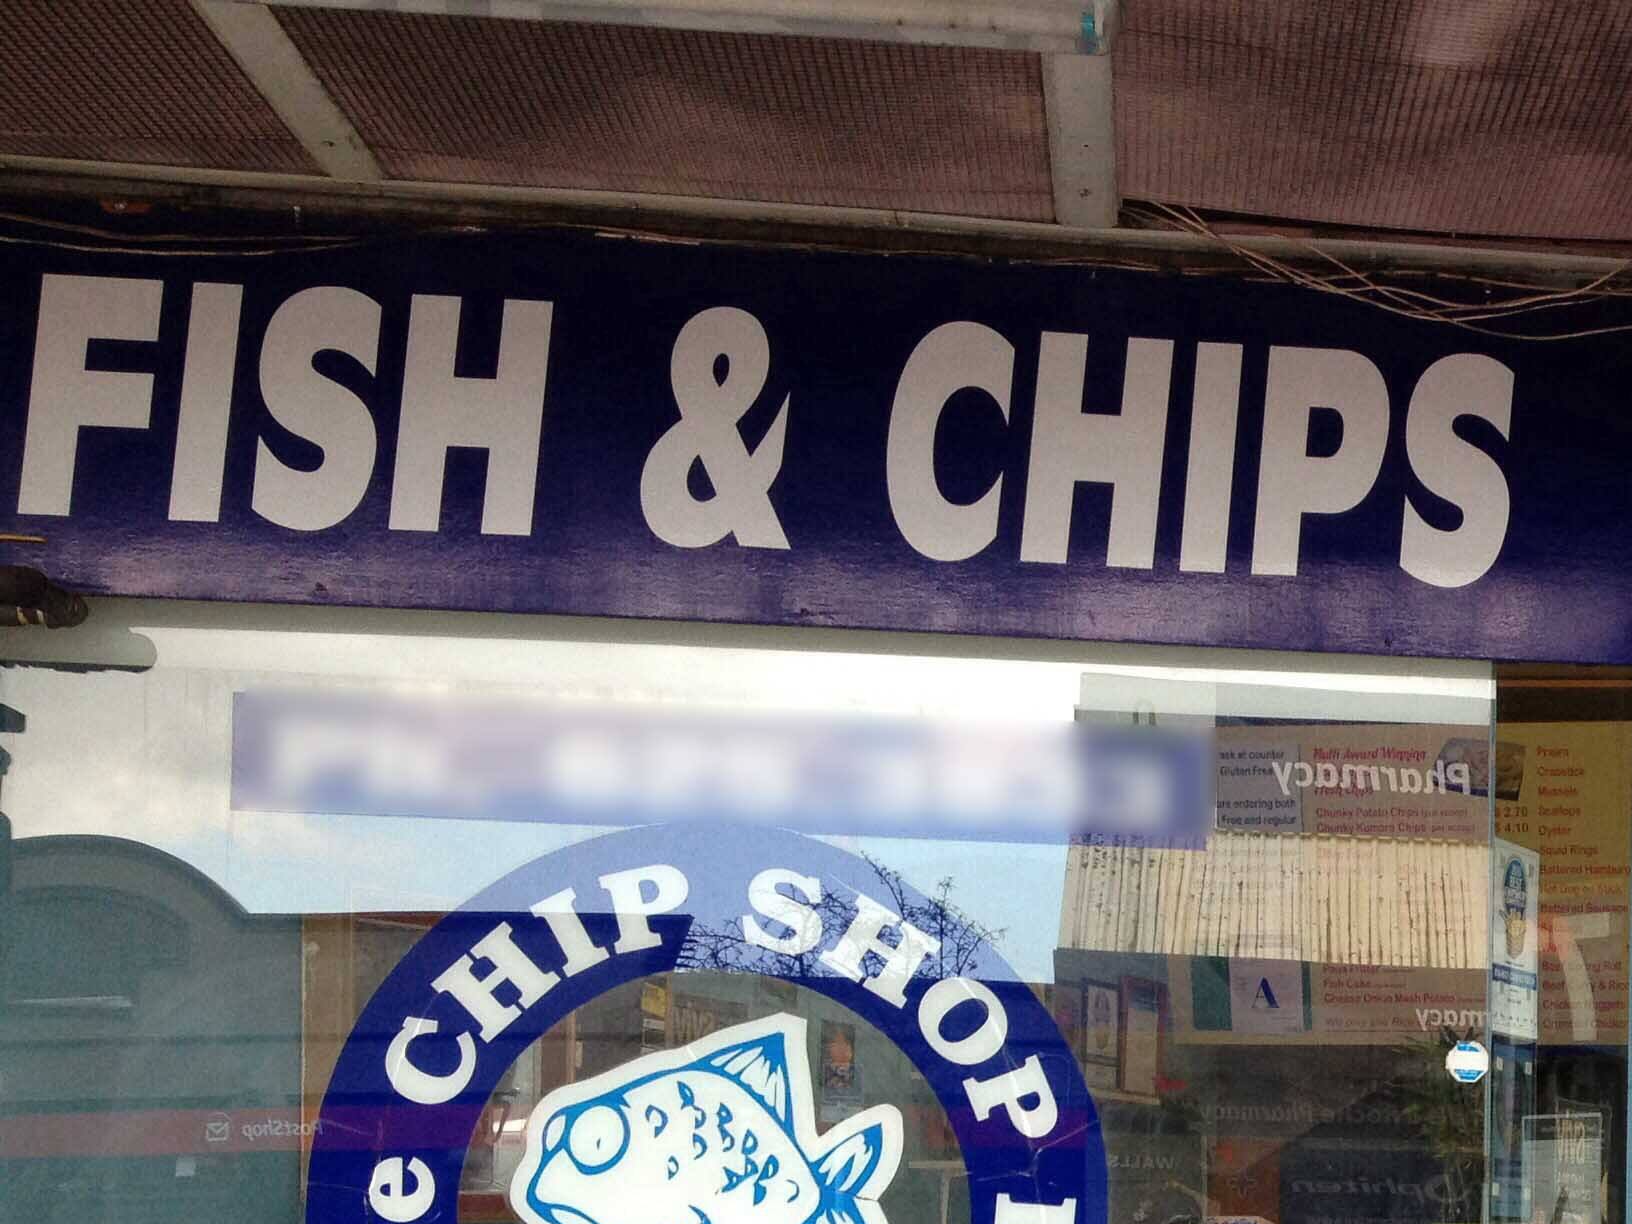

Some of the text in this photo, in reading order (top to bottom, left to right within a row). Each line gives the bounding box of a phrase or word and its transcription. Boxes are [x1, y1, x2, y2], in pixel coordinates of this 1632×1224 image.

[16, 273, 1515, 588] FISH & CHIPS
[385, 865, 690, 1105] CHIP
[741, 867, 1058, 1138] SHOP
[1252, 977, 1280, 1009] A
